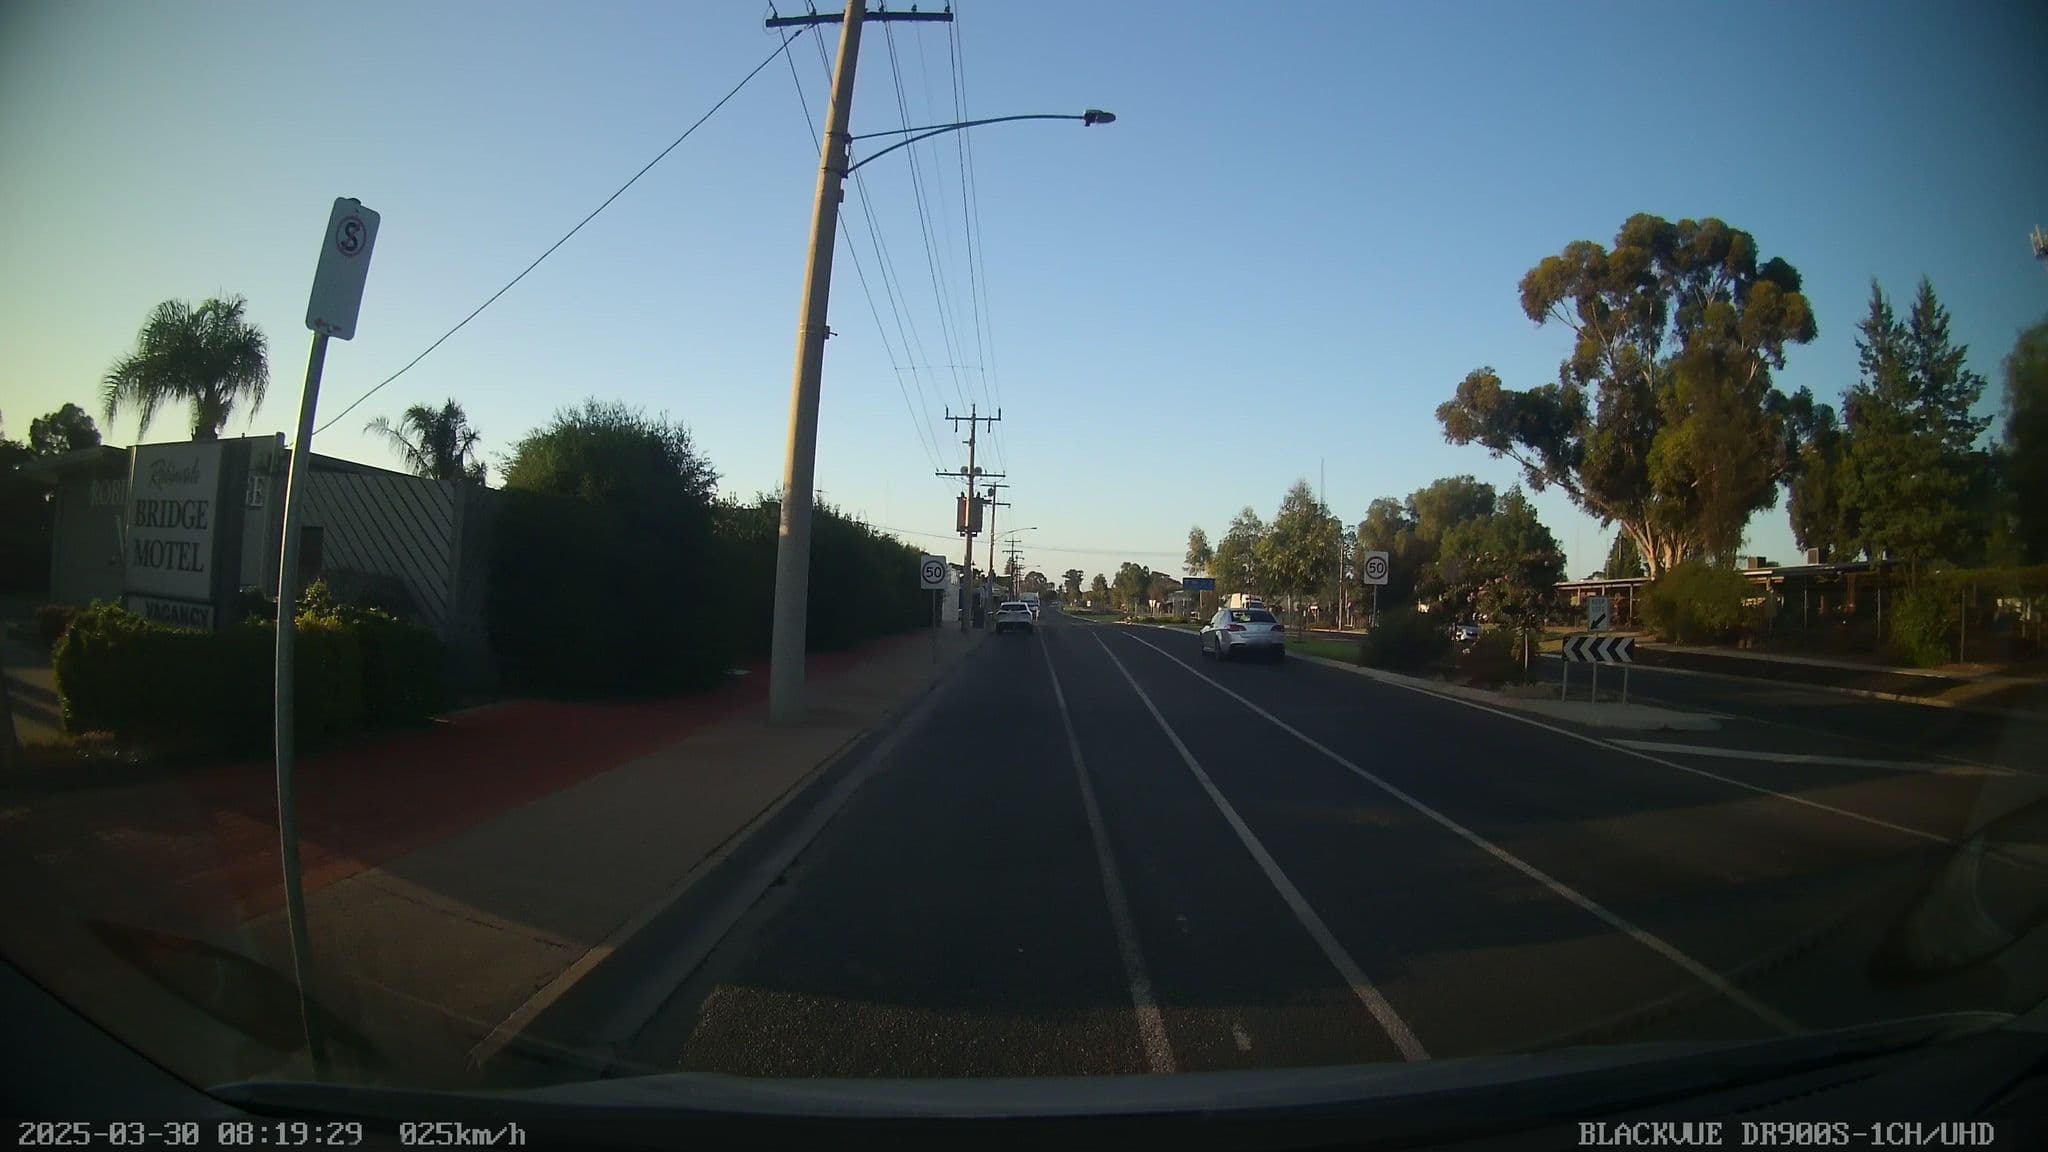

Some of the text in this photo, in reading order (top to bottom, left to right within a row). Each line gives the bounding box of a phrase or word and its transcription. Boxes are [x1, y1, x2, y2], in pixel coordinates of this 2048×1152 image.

[340, 222, 361, 251] S
[135, 499, 209, 530] BRIDGE
[133, 539, 204, 573] MOTEL
[1369, 561, 1384, 574] 50
[926, 566, 942, 578] 50
[144, 600, 209, 627] VACANCY
